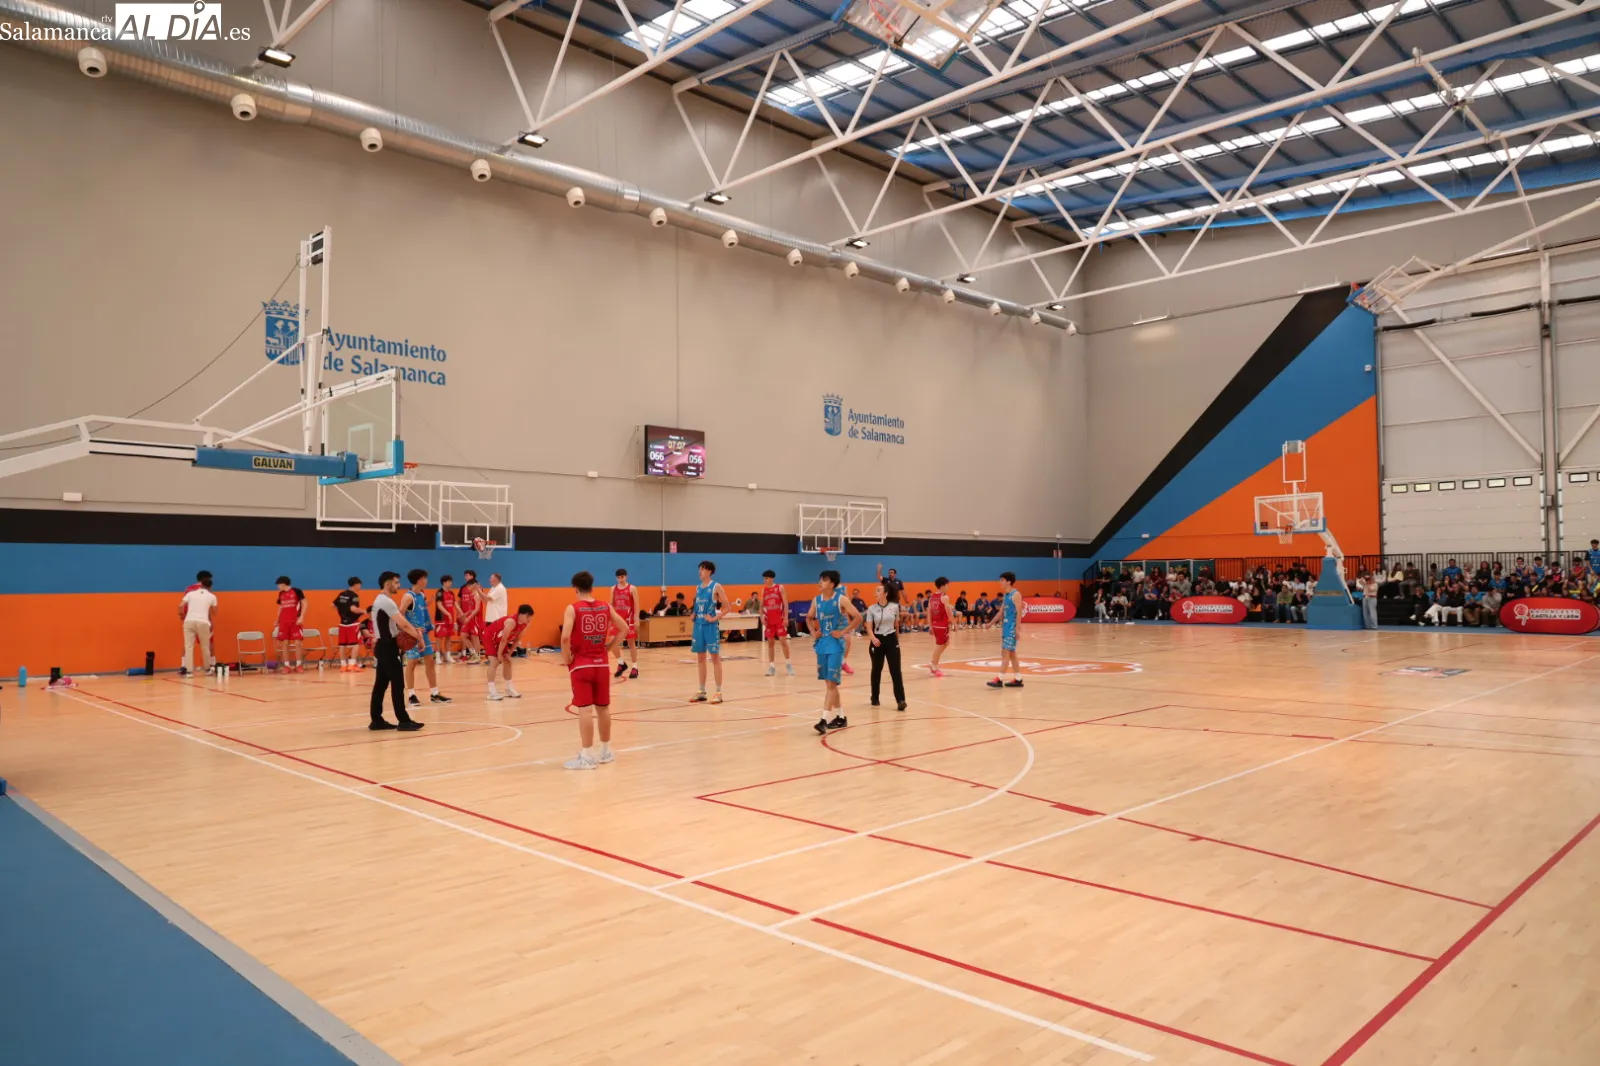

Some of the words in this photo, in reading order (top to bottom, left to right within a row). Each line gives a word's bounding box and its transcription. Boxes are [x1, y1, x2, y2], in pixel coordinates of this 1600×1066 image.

[323, 352, 344, 372] de
[848, 408, 905, 429] Ayuntamiento
[848, 425, 859, 439] de
[861, 427, 905, 445] Salamanca
[253, 456, 293, 470] GALVAN
[581, 613, 607, 634] 68
